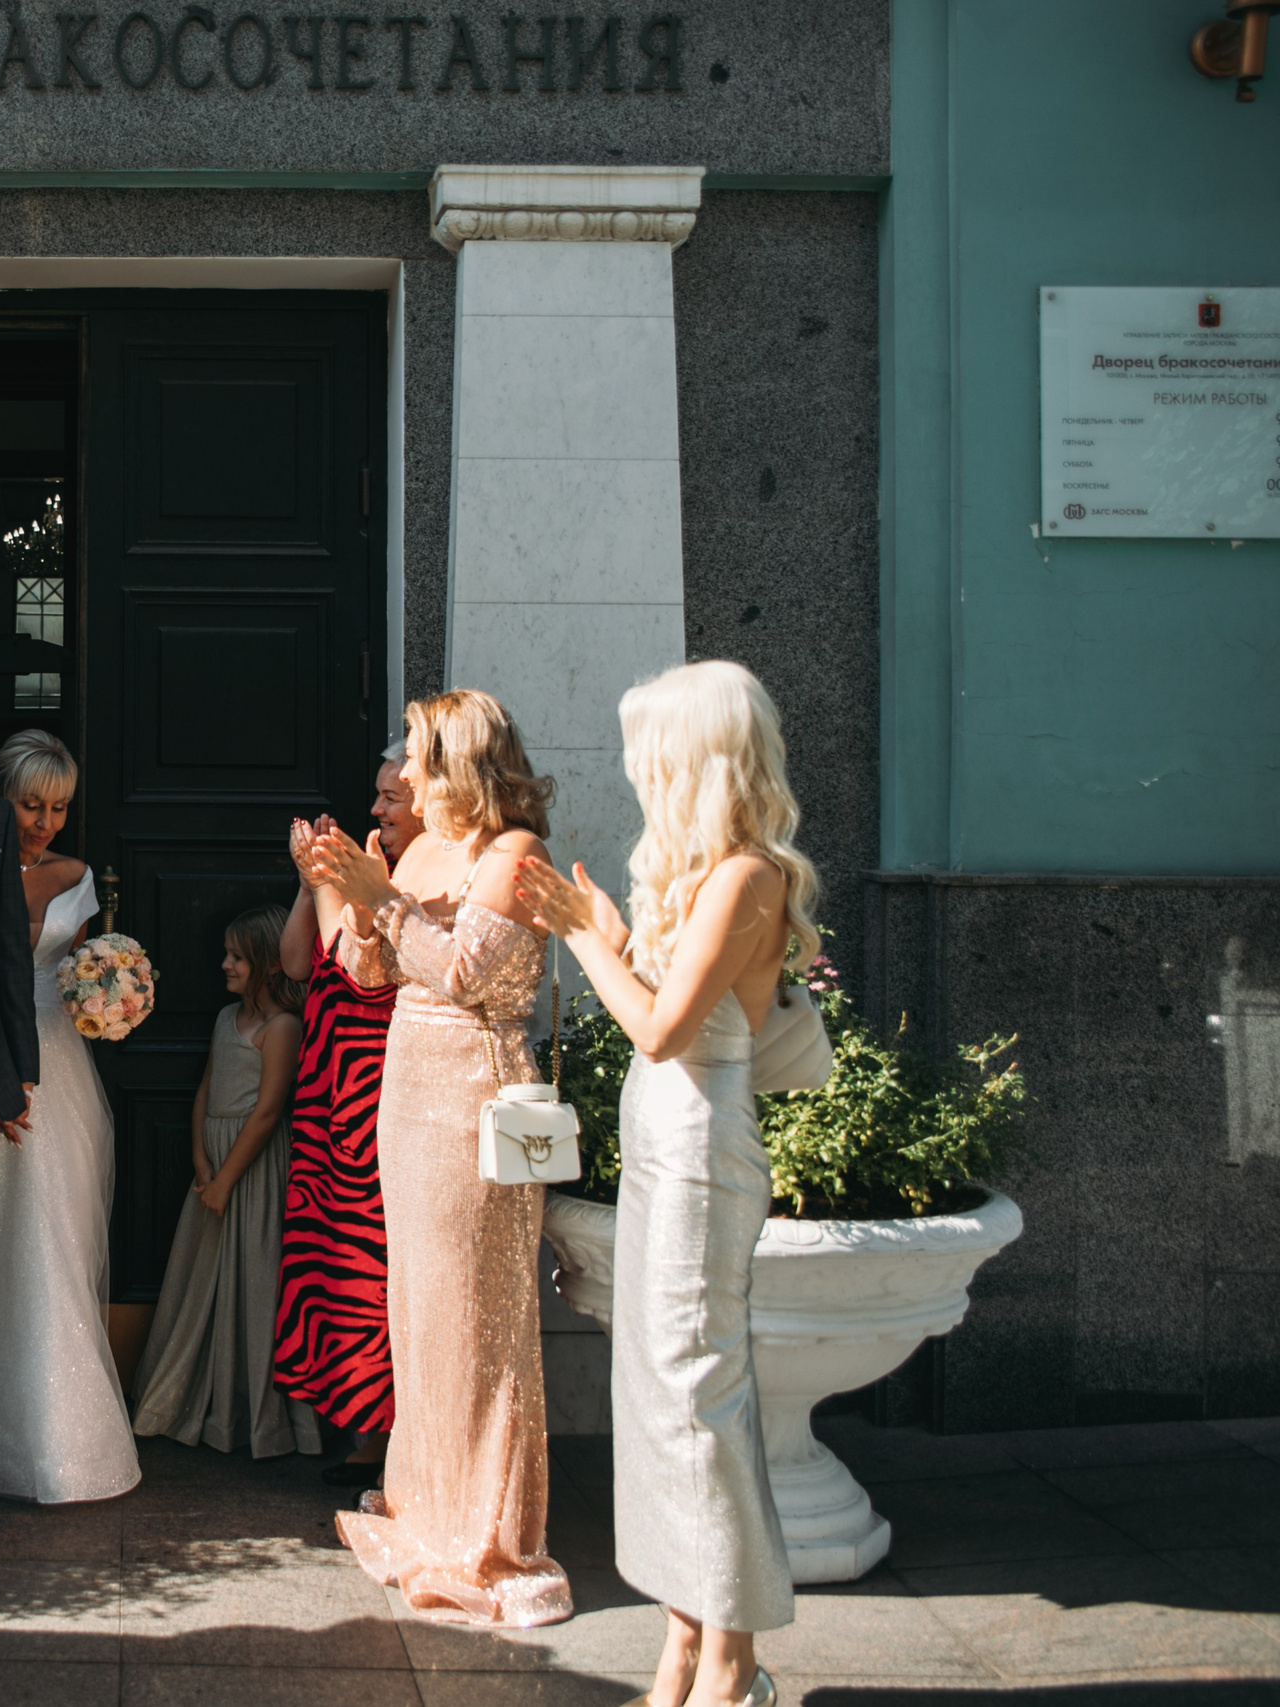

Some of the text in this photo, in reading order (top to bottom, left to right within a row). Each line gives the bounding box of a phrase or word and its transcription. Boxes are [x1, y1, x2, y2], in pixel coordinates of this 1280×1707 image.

[1092, 355, 1154, 371] Дворец
[1153, 392, 1267, 405] РЕЖИМ РАБОТЫ
[1062, 417, 1113, 425] ПОНЕДЕЛЬНИК
[1118, 417, 1145, 425] ЧЕТВЕРГ
[1062, 439, 1095, 447] ПЯТНИЦА
[1062, 460, 1093, 468] СУББОТА
[1062, 482, 1110, 490] ВОСКРЕСЕНЬЕ
[1091, 508, 1148, 516] ЗАГС МОСКВЫ
